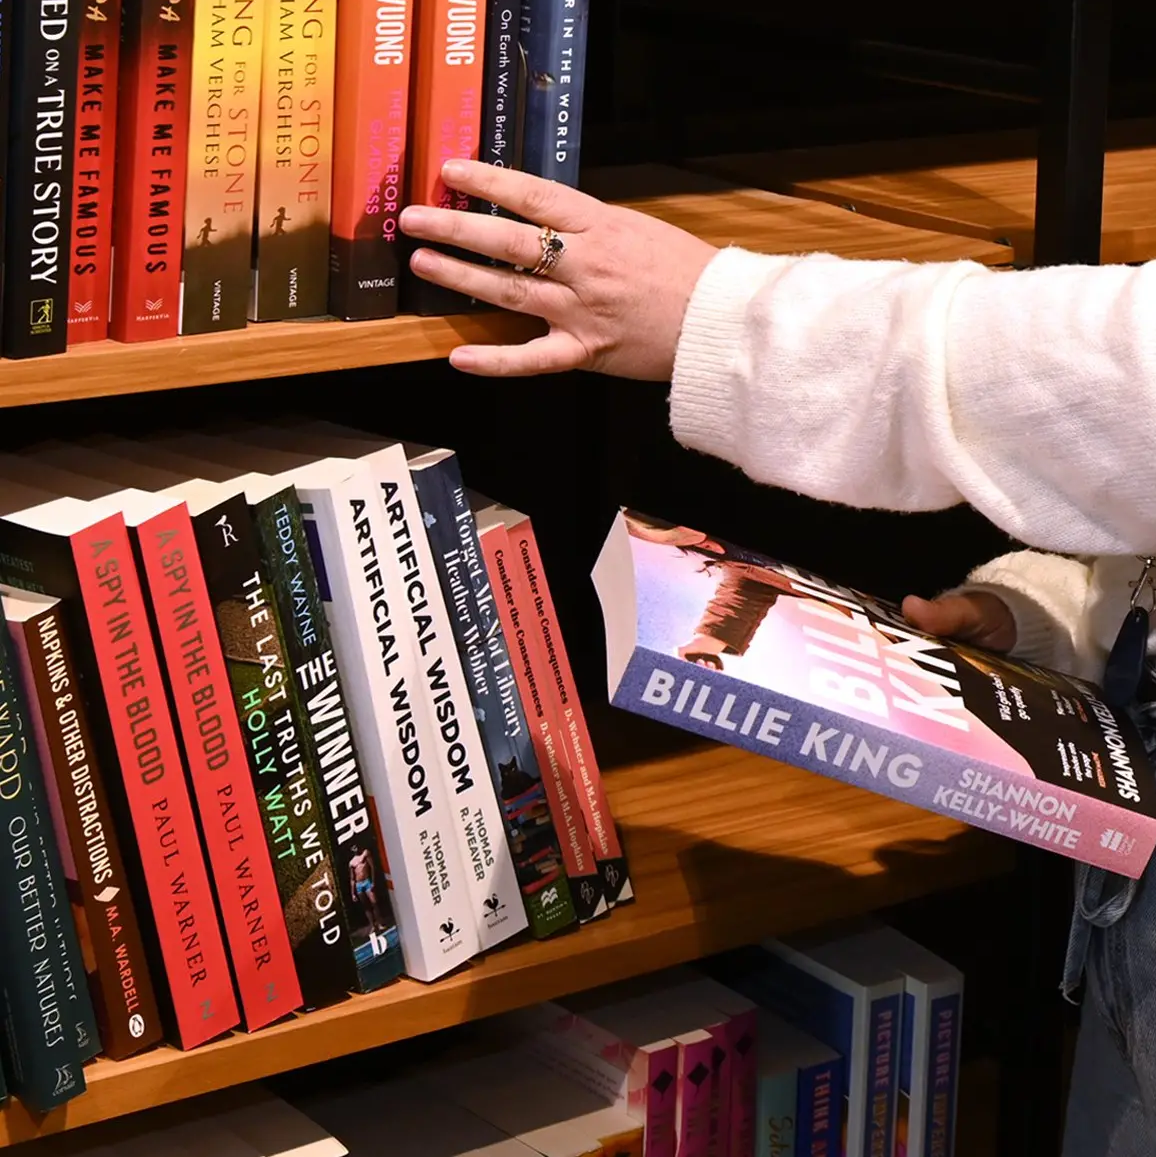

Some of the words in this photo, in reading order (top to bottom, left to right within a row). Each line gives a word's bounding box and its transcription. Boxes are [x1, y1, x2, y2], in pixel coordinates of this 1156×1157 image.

[499, 34, 512, 68] Earth
[500, 9, 512, 30] On
[563, 18, 574, 38] IN
[44, 48, 59, 72] ON
[81, 44, 104, 113] MAKE
[154, 44, 178, 112] MAKE
[233, 61, 247, 96] FOR
[304, 53, 318, 88] FOR
[496, 71, 512, 112] We're
[560, 48, 573, 85] THE
[34, 89, 65, 174] TRUE
[204, 57, 224, 179] VERGHESE
[275, 50, 295, 169] VERGHESE
[388, 87, 405, 119] THE
[491, 115, 507, 154] Briefly
[555, 93, 570, 163] WORLD
[79, 124, 101, 158] ME
[152, 123, 173, 157] ME
[223, 108, 248, 214] STONE
[297, 99, 321, 204] STONE
[365, 119, 384, 215] GLADNESS
[383, 126, 402, 213] EMPEROR
[30, 181, 62, 285] STORY
[74, 170, 100, 276] FAMOUS
[145, 169, 173, 274] FAMOUS
[382, 217, 397, 243] OF
[212, 279, 222, 321] VINTAGE
[288, 267, 298, 308] VINTAGE
[358, 277, 395, 289] VINTAGE
[90, 538, 114, 558] A
[156, 528, 179, 548] A
[95, 558, 126, 608] SPY
[161, 549, 192, 597] SPY
[243, 571, 269, 628] THE
[274, 503, 299, 565] TEDDY
[291, 571, 317, 647] WAYNE
[107, 612, 133, 644] IN
[172, 601, 198, 632] IN
[380, 481, 437, 656] ARTIFICIAL
[426, 657, 474, 795] WISDOM
[443, 548, 471, 623] Heather
[463, 623, 490, 697] Webber
[455, 508, 504, 656] Forget-Me-Not
[493, 657, 523, 738] Library
[38, 615, 70, 693] NAPKINS
[114, 642, 146, 697] THE
[180, 630, 210, 685] THE
[256, 634, 287, 703] LAST
[296, 650, 337, 690] THE
[349, 499, 400, 677] ARTIFICIAL
[390, 677, 433, 817] WISDOM
[55, 693, 73, 711] &
[192, 683, 230, 772] BLOOD
[494, 549, 515, 607] Consider
[510, 605, 520, 628] the
[515, 629, 544, 718] Consequences
[543, 734, 560, 779] Webster
[555, 778, 566, 800] and
[568, 825, 585, 872] Hopkins
[519, 539, 539, 595] Consider
[534, 594, 545, 618] the
[540, 617, 568, 705] Consequences
[568, 721, 584, 765] Webster
[579, 764, 591, 786] and
[592, 811, 609, 856] Hopkins
[640, 669, 793, 746] BILLIE
[799, 721, 924, 789] KING
[59, 710, 87, 766] OTHER
[126, 696, 165, 785] BLOOD
[273, 710, 312, 817] TRUTHS
[306, 680, 370, 845] WINNER
[242, 688, 278, 775] HOLLY
[264, 784, 296, 860] WATT
[958, 767, 1077, 823] SHANNON
[8, 816, 33, 871] OUR
[71, 764, 113, 885] DISTRACTIONS
[152, 798, 180, 867] PAUL
[217, 784, 244, 852] PAUL
[299, 822, 325, 869] WE
[473, 808, 495, 868] THOMAS
[933, 786, 1082, 851] KELLY-WHITE
[423, 847, 443, 906] WEAVER
[431, 831, 451, 891] THOMAS
[464, 823, 486, 882] WEAVER
[18, 874, 48, 953] BETTER
[105, 905, 122, 943] M.A.
[170, 872, 208, 988] WARNER
[235, 857, 272, 971] WARNER
[311, 872, 341, 946] TOLD
[33, 957, 65, 1048] NATURES
[114, 943, 141, 1013] WARDELL
[873, 1009, 893, 1090] PICTURE
[934, 1007, 954, 1094] PICTURE
[813, 1070, 831, 1135] THINK
